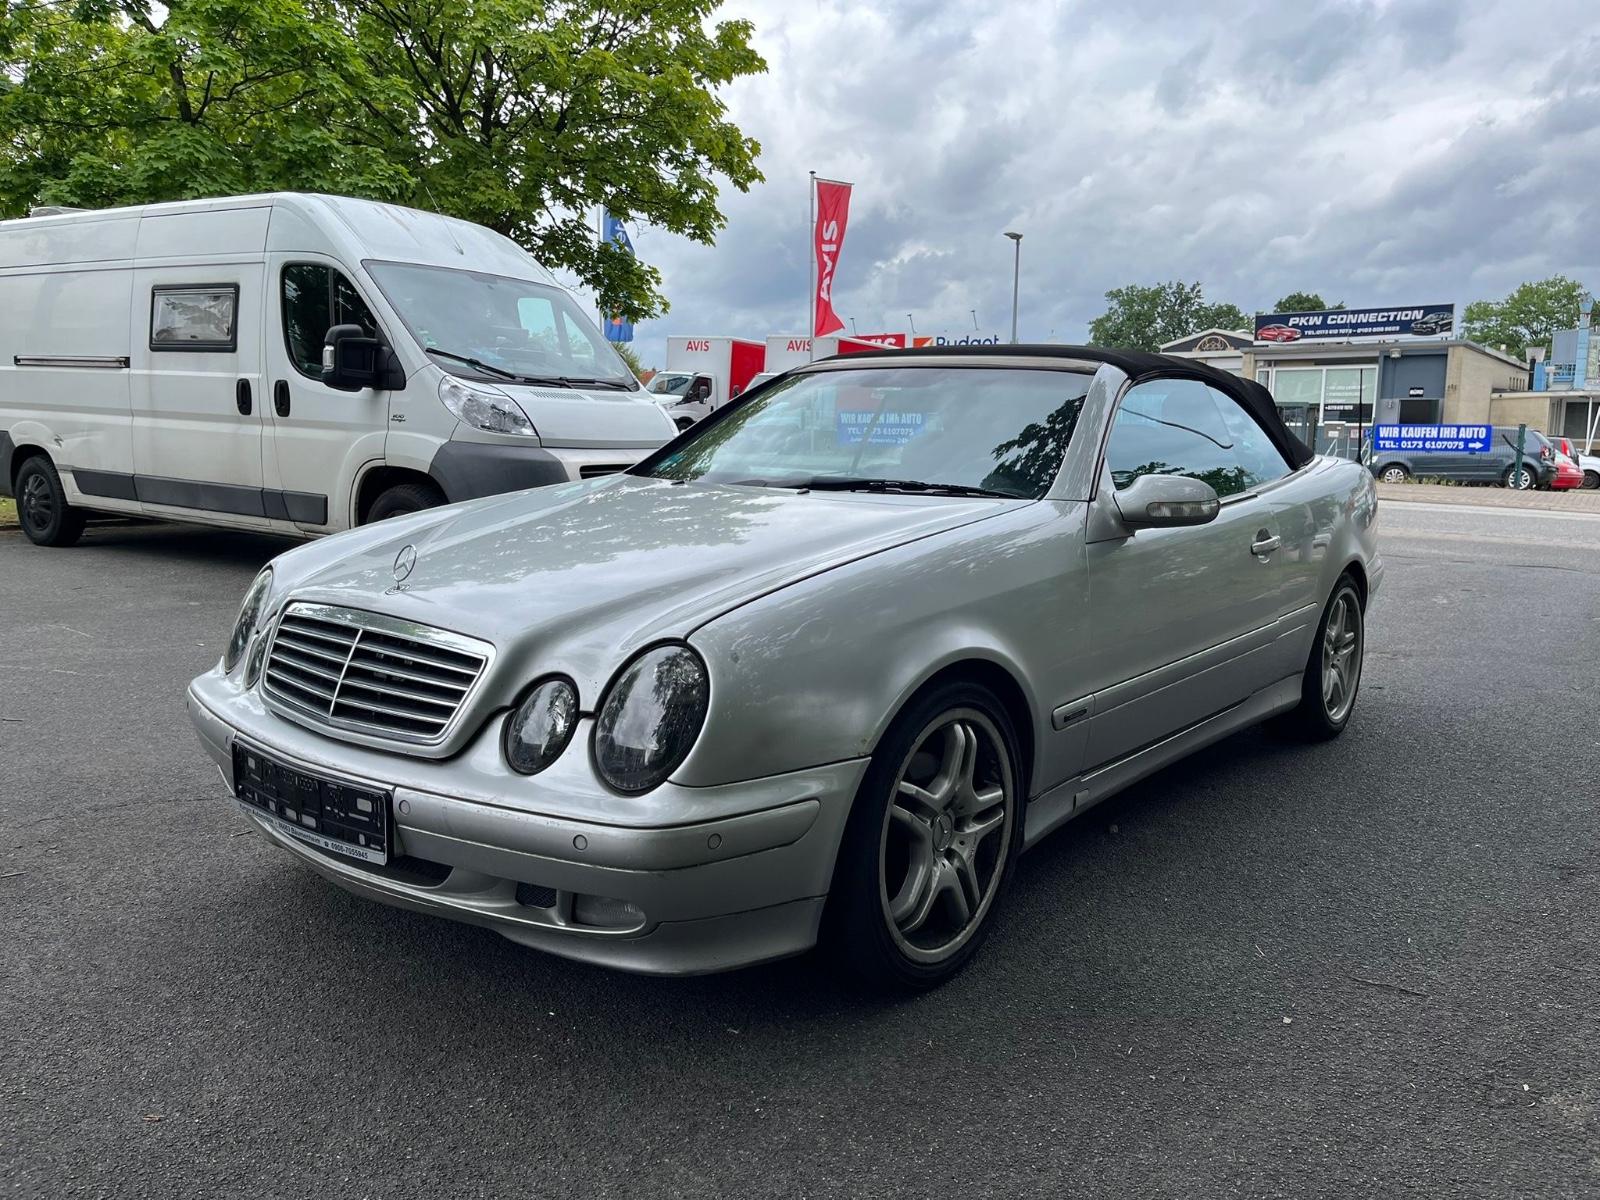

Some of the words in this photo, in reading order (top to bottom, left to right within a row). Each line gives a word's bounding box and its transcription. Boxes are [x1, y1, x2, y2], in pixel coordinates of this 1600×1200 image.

[820, 220, 838, 302] AVIS
[1288, 315, 1323, 327] PKW
[1327, 310, 1424, 325] CONNECTION
[686, 340, 710, 352] AVIS
[786, 339, 812, 352] AVIS
[857, 413, 884, 424] KAUN
[901, 413, 922, 424] AUTO
[1379, 426, 1399, 438] WIR
[1401, 426, 1438, 438] KAUFEN
[1439, 427, 1457, 439] IHR
[1459, 427, 1486, 439] AUTO
[1379, 440, 1399, 448] TEL:
[1401, 440, 1423, 449] 0173
[1424, 440, 1465, 449] 6107075
